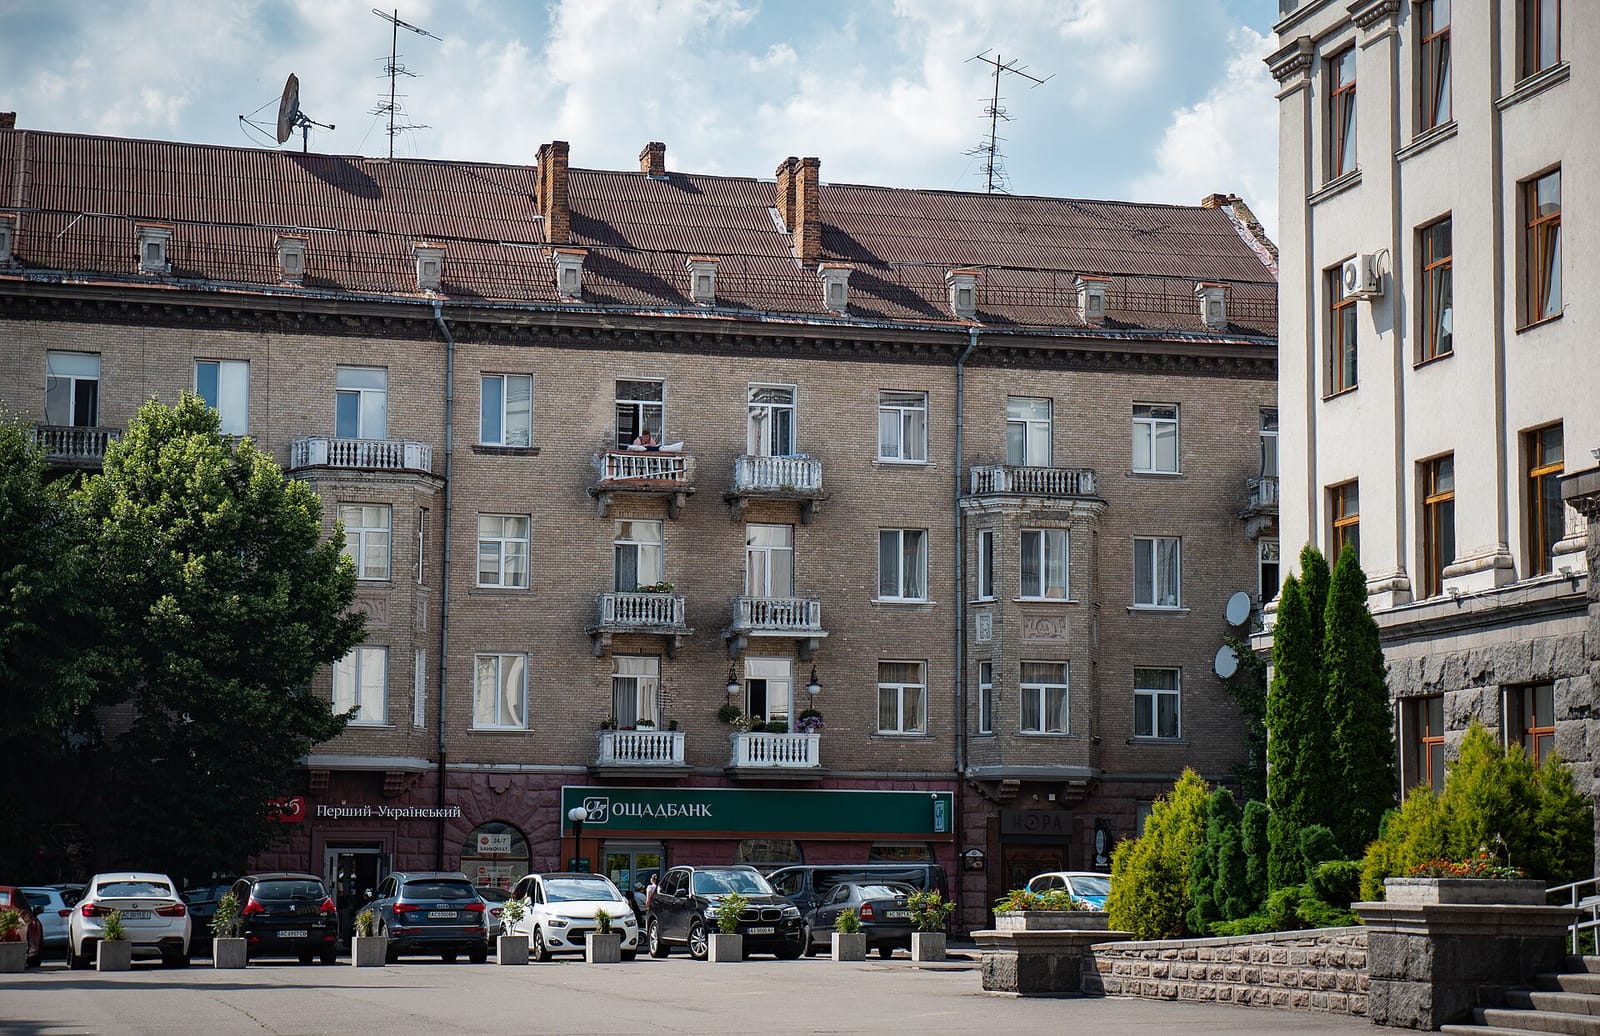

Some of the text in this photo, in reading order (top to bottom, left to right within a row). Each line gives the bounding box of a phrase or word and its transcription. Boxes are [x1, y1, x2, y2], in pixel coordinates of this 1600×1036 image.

[316, 804, 372, 819] Перший
[378, 805, 462, 820] Український
[612, 802, 713, 819] ОЩАДБАНК
[1014, 814, 1062, 832] НОРА
[492, 837, 507, 845] 24/7
